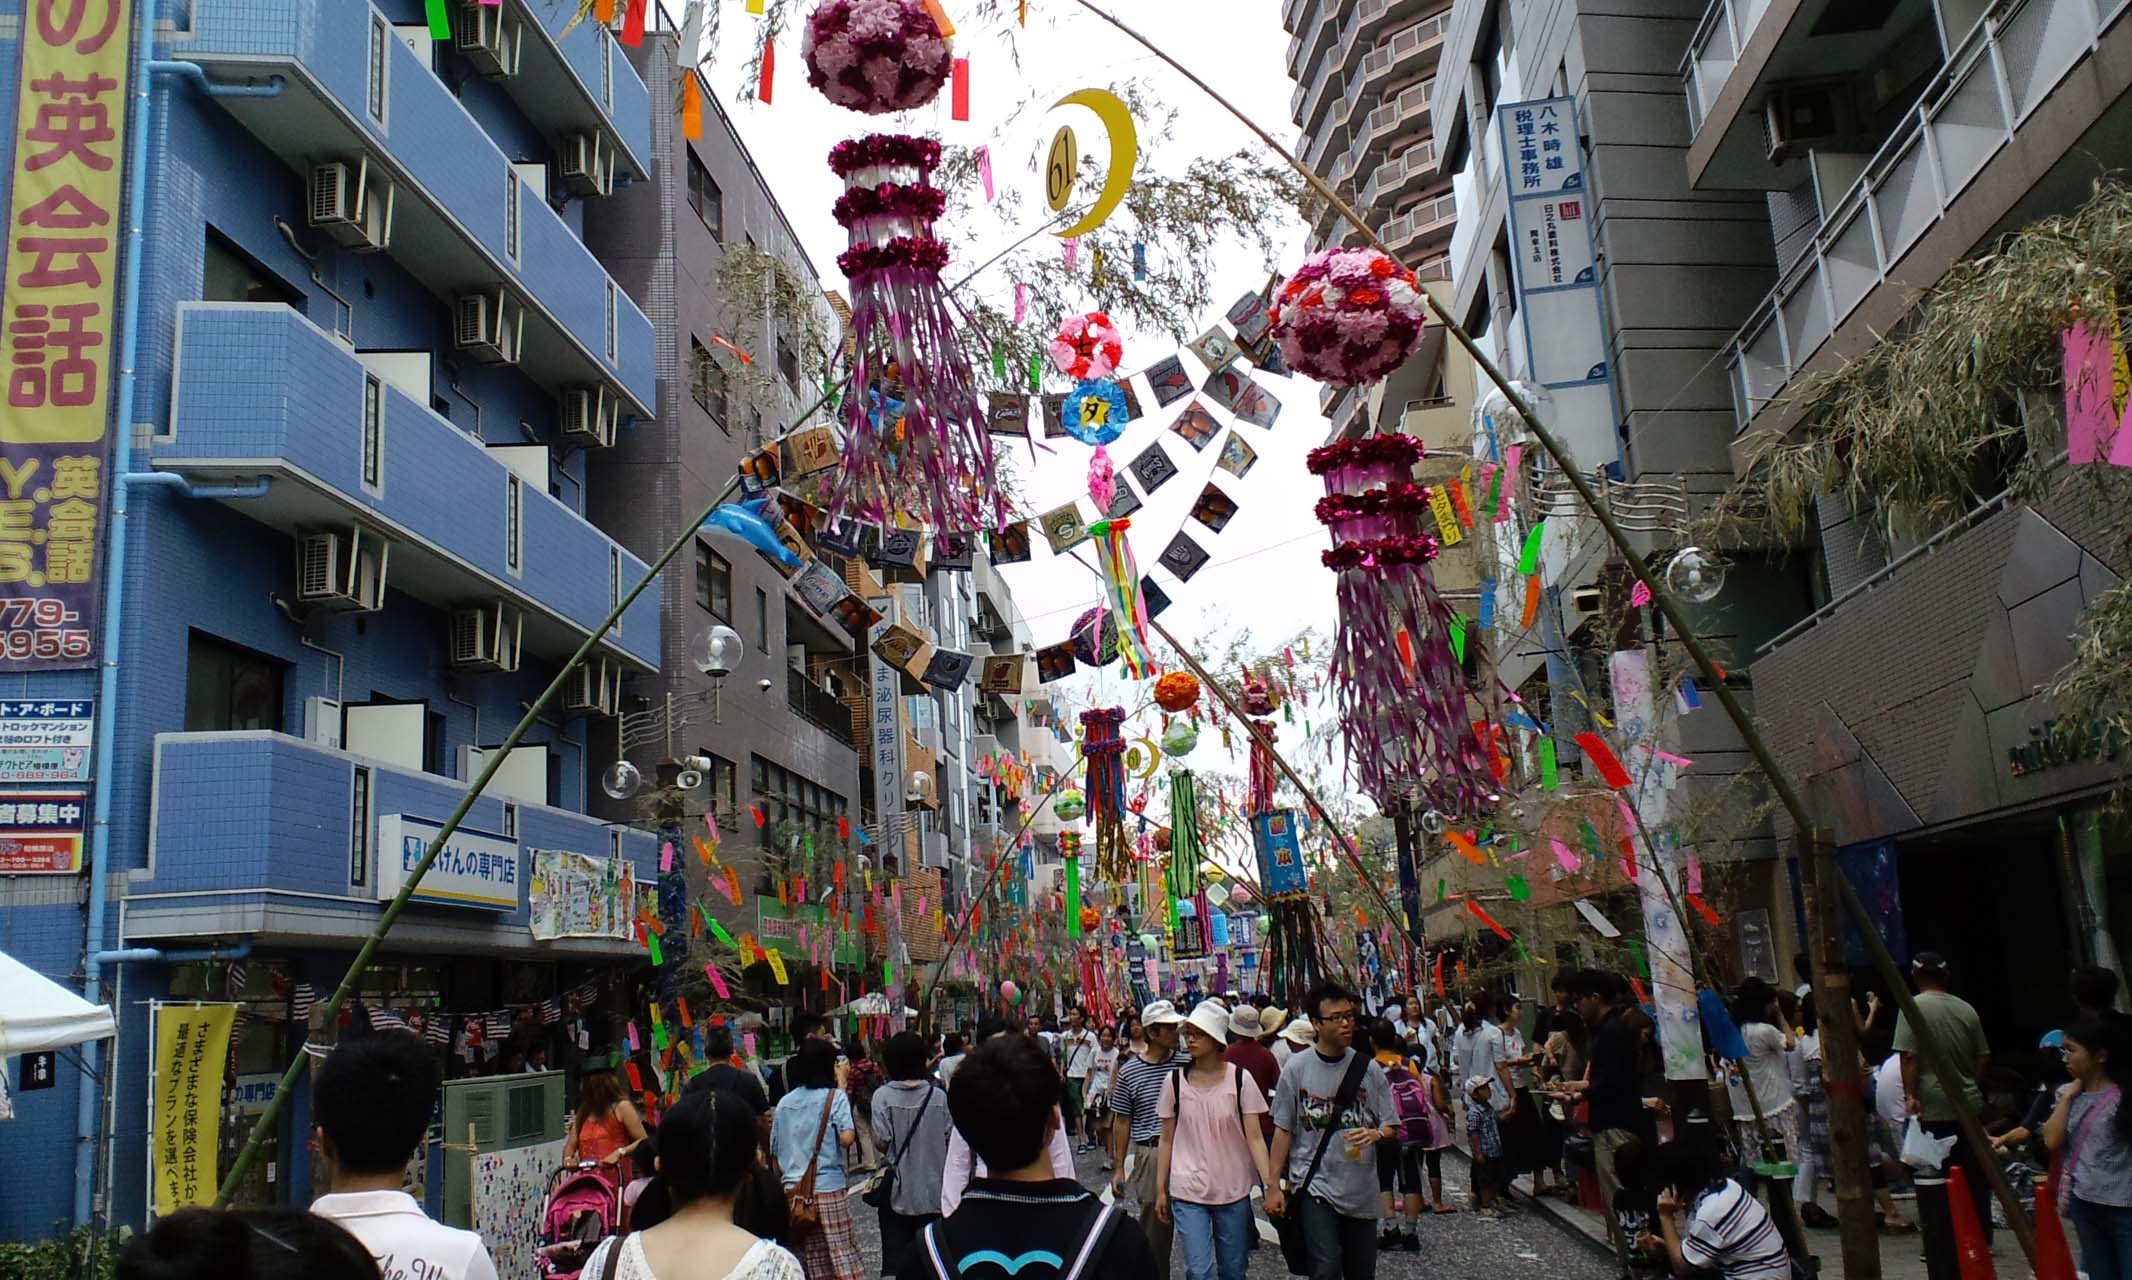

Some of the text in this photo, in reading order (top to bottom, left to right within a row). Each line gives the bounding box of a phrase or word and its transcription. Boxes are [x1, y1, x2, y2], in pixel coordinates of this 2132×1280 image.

[1515, 110, 1542, 188] 税理士事務所
[46, 455, 101, 584] 英会話
[0, 629, 90, 659] 955
[183, 1021, 211, 1204] さまざまな保険会社か
[374, 1253, 408, 1280] he
